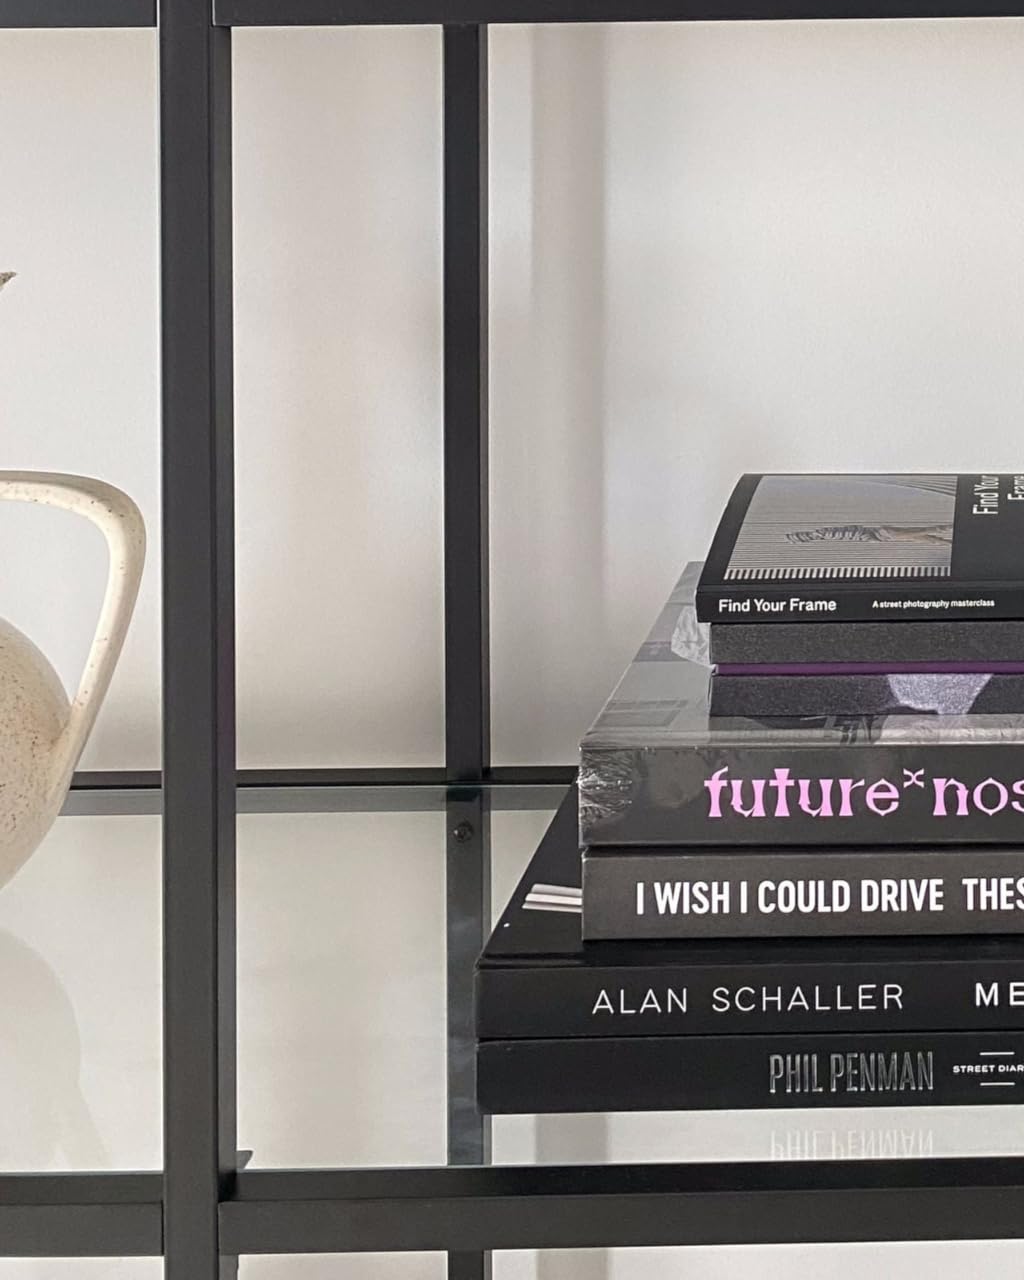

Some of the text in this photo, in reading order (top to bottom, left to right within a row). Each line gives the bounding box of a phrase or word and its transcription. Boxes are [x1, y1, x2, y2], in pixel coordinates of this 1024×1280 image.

[973, 492, 999, 514] Find
[718, 598, 837, 612] Find Your Frame
[880, 600, 902, 608] street
[903, 600, 950, 610] photography
[951, 599, 995, 608] masterclass
[704, 767, 899, 817] future
[636, 882, 644, 915] I
[653, 881, 730, 915] WISH
[740, 881, 748, 914] I
[758, 880, 850, 913] COULD
[861, 878, 944, 912] DRIVE
[592, 984, 903, 1014] ALAN SCHALLER
[769, 1051, 934, 1093] PHIL PENMAN
[952, 1064, 995, 1074] STREET
